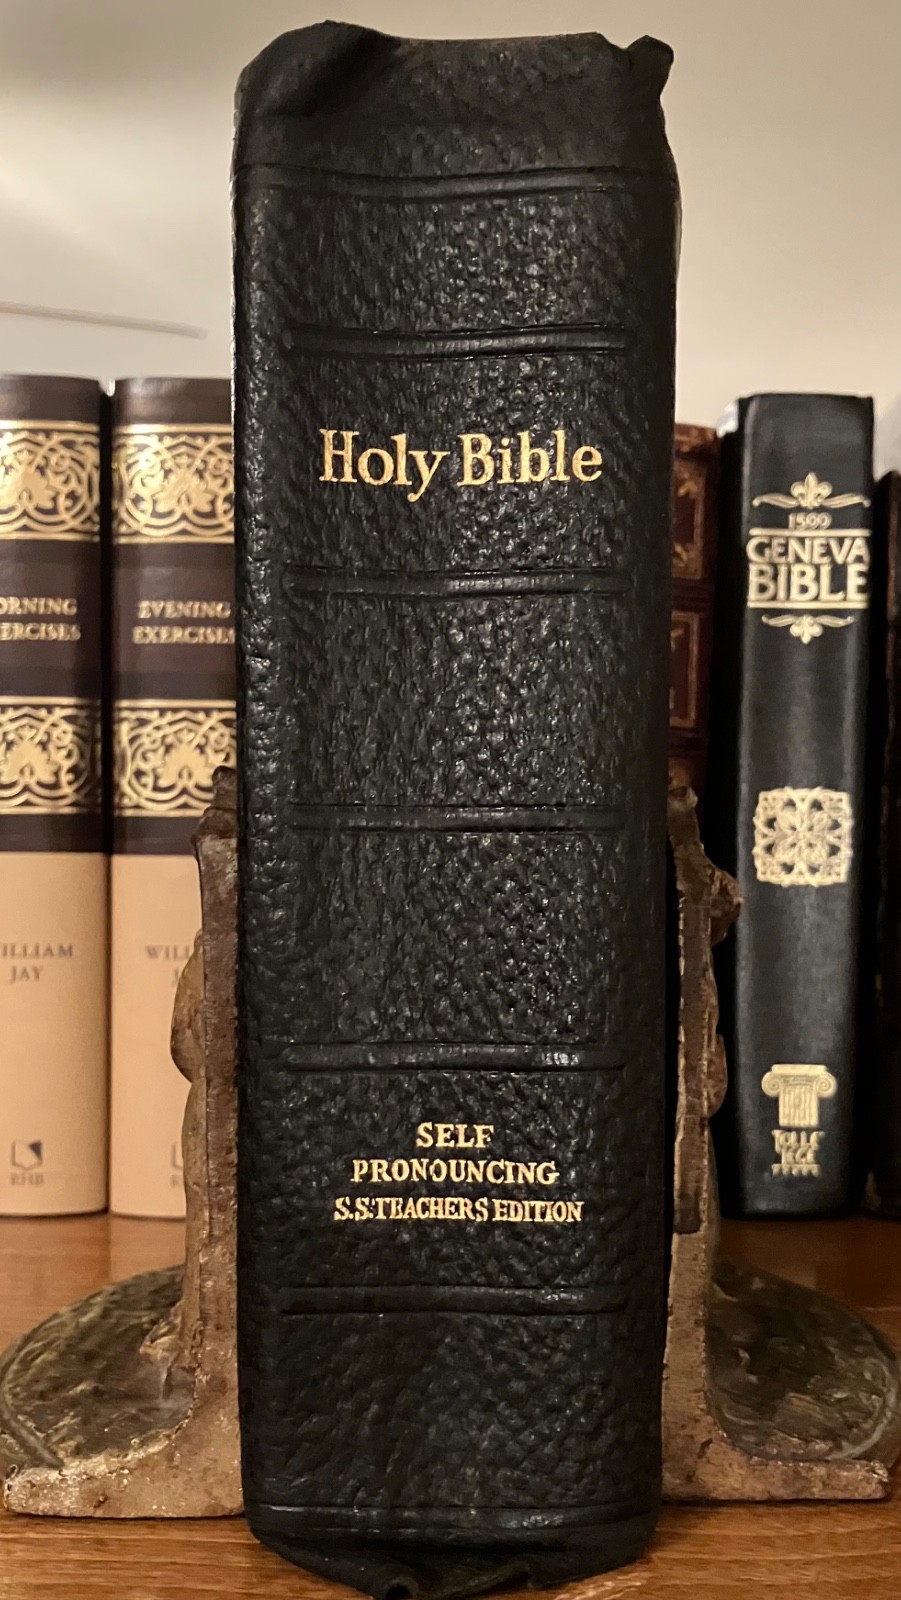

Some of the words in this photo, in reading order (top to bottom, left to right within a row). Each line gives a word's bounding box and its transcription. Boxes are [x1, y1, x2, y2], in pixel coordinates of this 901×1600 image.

[319, 428, 450, 502] Holy
[457, 430, 603, 486] Bible
[746, 536, 870, 565] GENEVA
[748, 563, 869, 601] BIBLE
[138, 600, 231, 618] EVENING
[10, 965, 44, 984] JAY
[416, 1122, 494, 1148] SELF
[350, 1159, 560, 1185] PRONOUNCING
[375, 1197, 489, 1221] TEACHERS
[492, 1198, 584, 1222] EDITION
